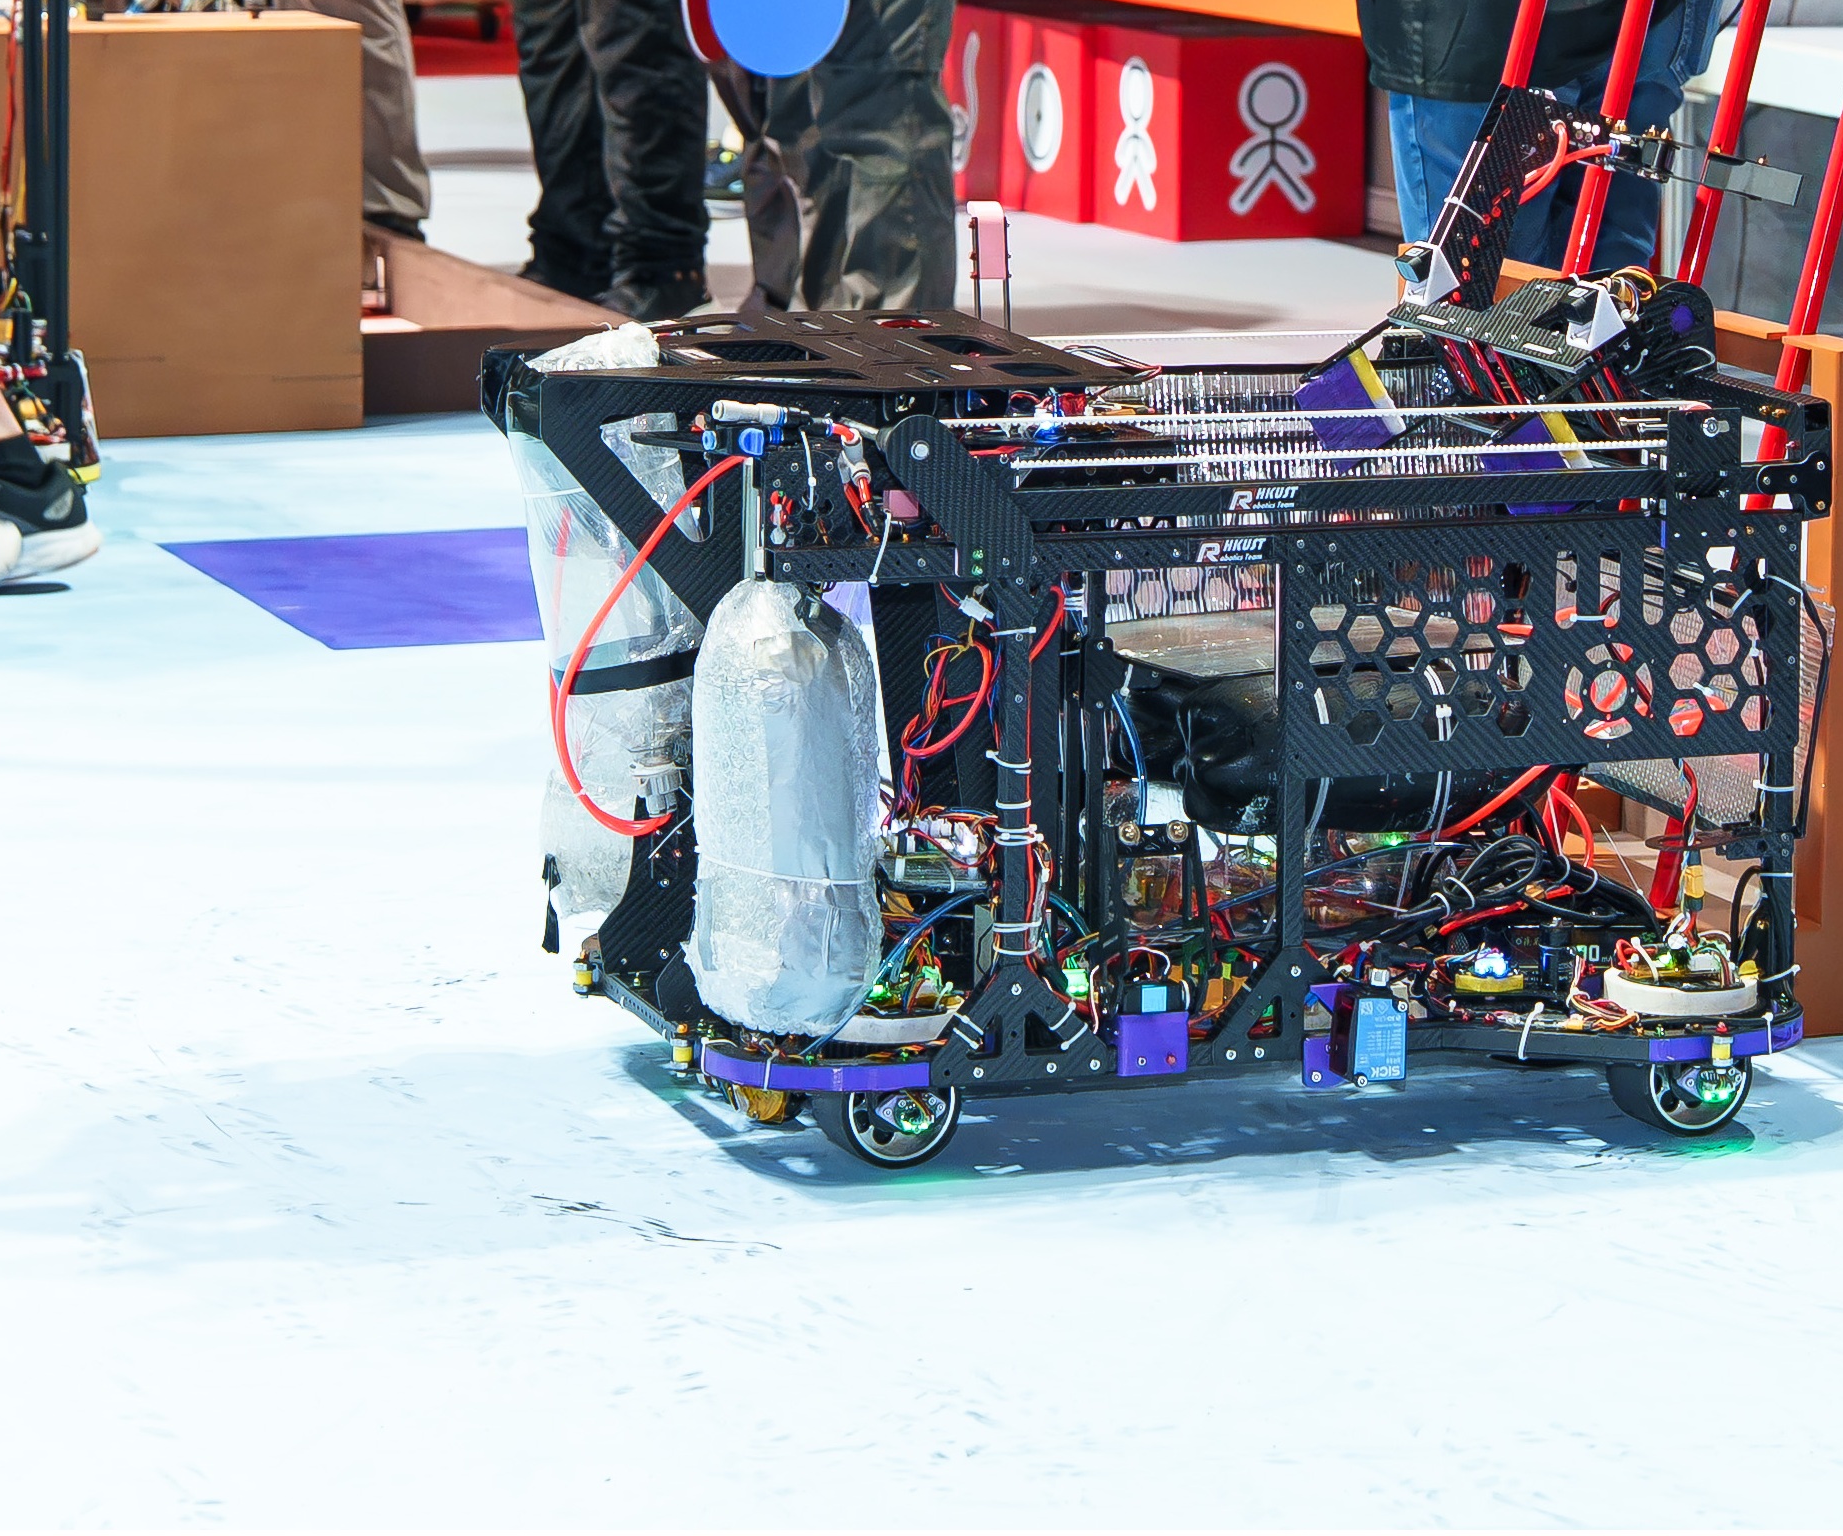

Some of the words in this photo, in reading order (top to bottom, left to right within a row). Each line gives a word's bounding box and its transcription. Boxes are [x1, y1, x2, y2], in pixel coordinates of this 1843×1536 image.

[1255, 486, 1299, 500] HKUST
[1223, 538, 1266, 552] HKUST
[1371, 1065, 1401, 1078] SICK
